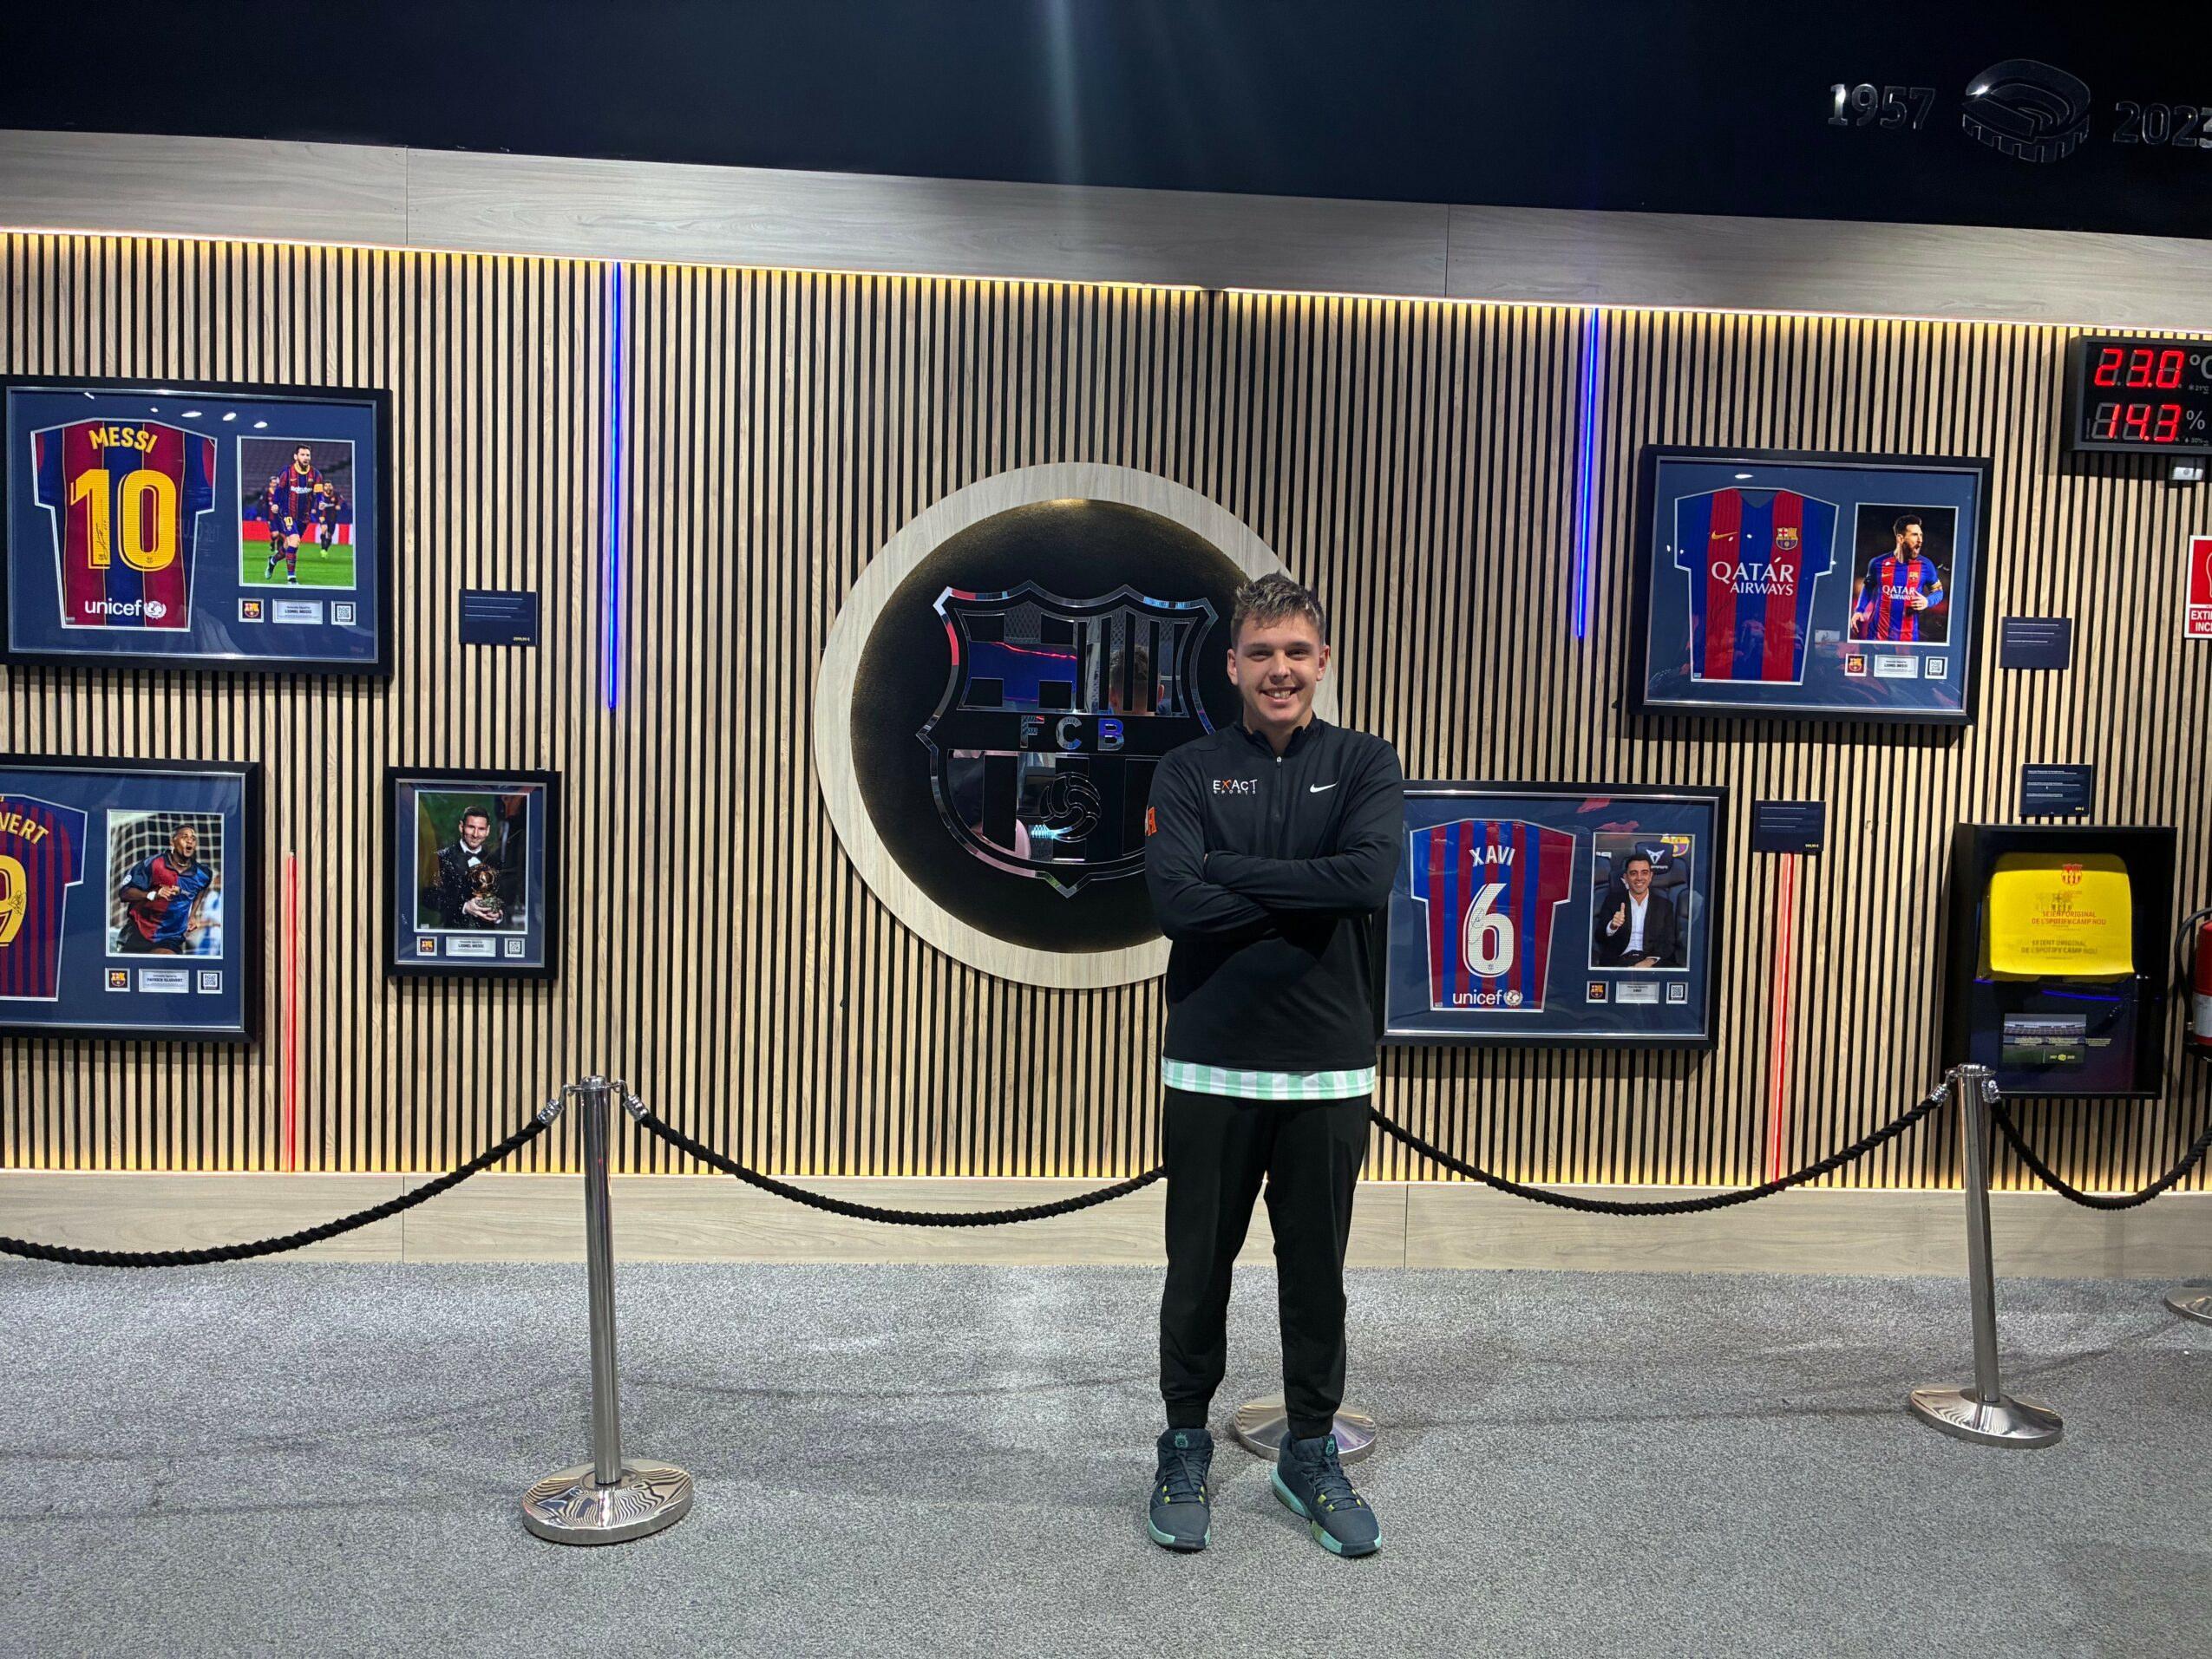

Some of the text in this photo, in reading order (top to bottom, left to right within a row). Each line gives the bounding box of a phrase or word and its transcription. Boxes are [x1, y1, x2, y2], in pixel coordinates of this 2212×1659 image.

[1828, 82, 1936, 130] 1957
[2094, 348, 2184, 389] 23.0
[2186, 409, 2206, 430] %
[88, 427, 158, 454] MESSI
[70, 469, 177, 572] 10
[1711, 561, 1794, 585] QATAR
[1730, 581, 1794, 596] AIRWAYS
[1882, 585, 1915, 595] QATAR
[84, 598, 142, 616] unicef
[2191, 610, 2212, 620] EXTI
[2196, 622, 2212, 632] INC
[1213, 779, 1258, 791] EXACT
[1469, 845, 1515, 867] XAVI
[1463, 883, 1515, 978] 6
[1453, 989, 1503, 1005] unicef
